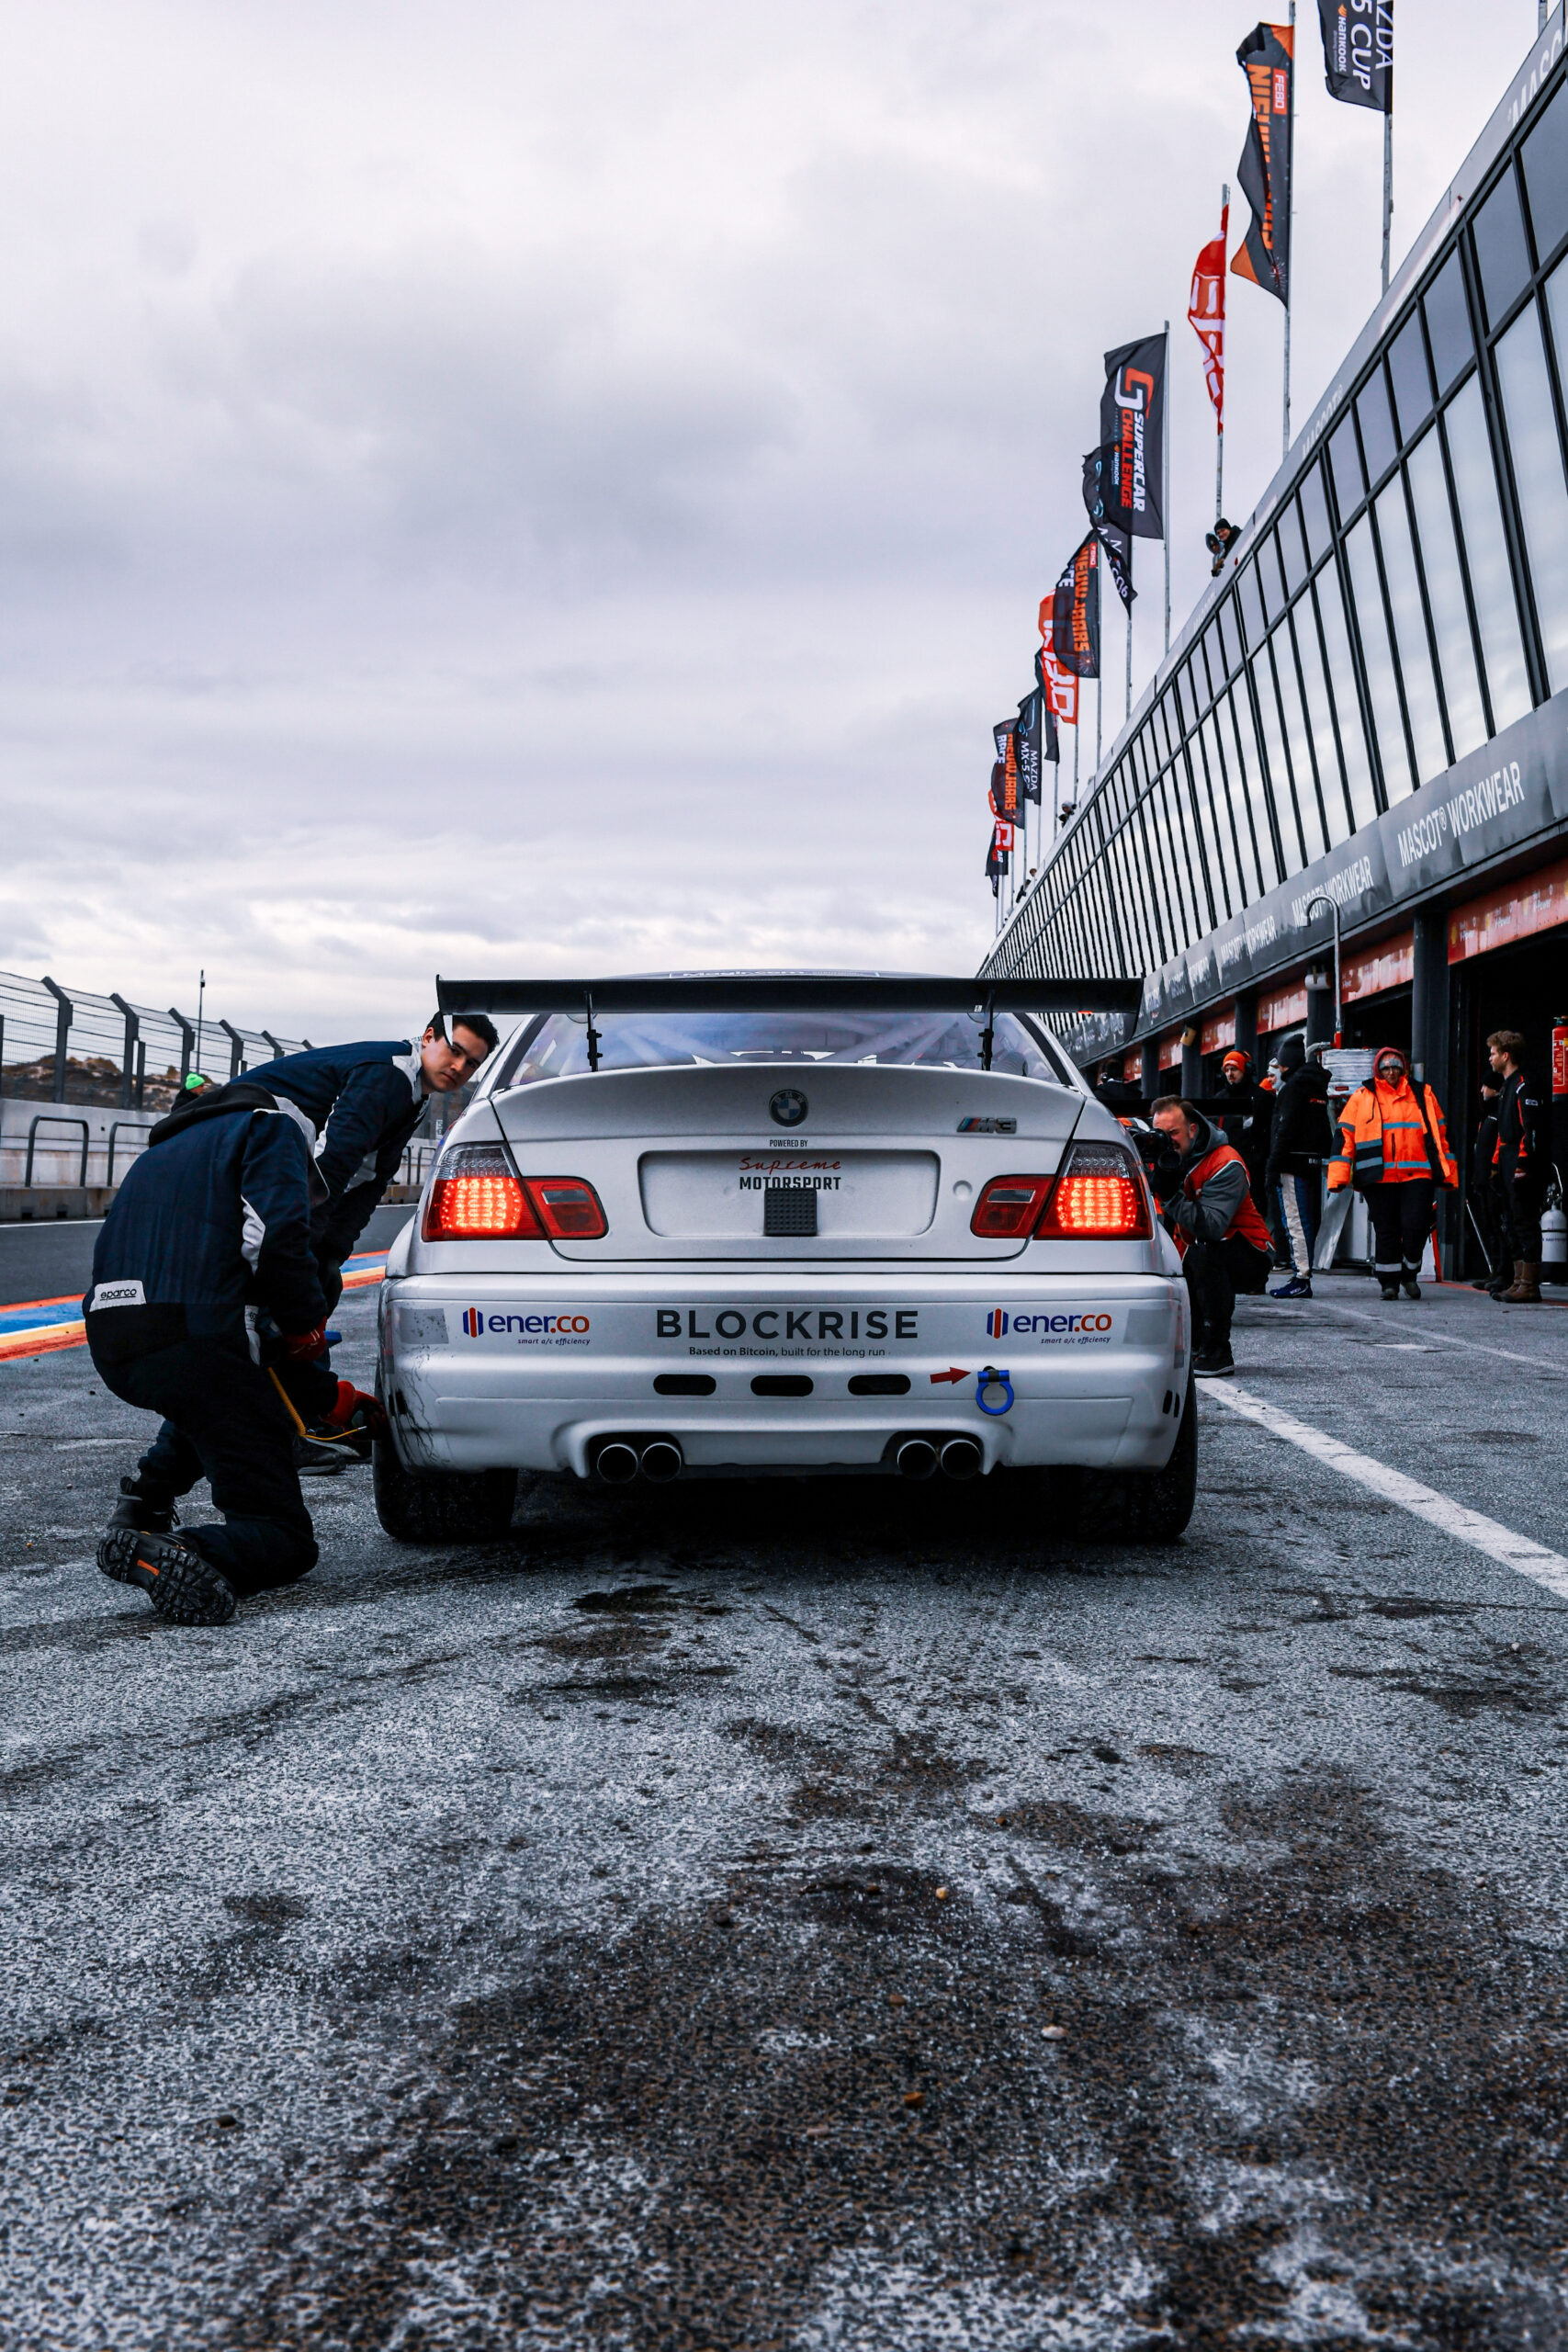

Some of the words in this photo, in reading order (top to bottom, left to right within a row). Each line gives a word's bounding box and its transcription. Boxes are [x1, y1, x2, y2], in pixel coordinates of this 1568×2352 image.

[1351, 23, 1372, 90] CUP
[1275, 74, 1285, 108] FEBO
[1121, 408, 1134, 509] CHALLENGE
[1133, 411, 1145, 513] SUPERCAR
[1021, 741, 1030, 772] MX-5
[1029, 750, 1038, 791] MAZDA
[1446, 761, 1526, 839] WORKWEAR
[1324, 855, 1374, 910] WORKWEAR
[972, 1116, 1017, 1134] M3
[769, 1139, 799, 1148] POWERED
[800, 1139, 808, 1148] BY
[739, 1157, 841, 1175] Supreme
[739, 1176, 841, 1190] MOTORSPORT
[488, 1315, 591, 1334] ener.co
[657, 1310, 919, 1340] BLOCKRISE
[1013, 1314, 1112, 1333] ener.co
[555, 1338, 591, 1346] efficiency
[689, 1346, 720, 1356] Based
[723, 1348, 737, 1356] on
[739, 1346, 778, 1357] Bitcoin,
[781, 1347, 805, 1356] built
[807, 1347, 820, 1356] for
[824, 1347, 840, 1356] the
[842, 1347, 865, 1358] long
[1077, 1336, 1111, 1345] efficiency
